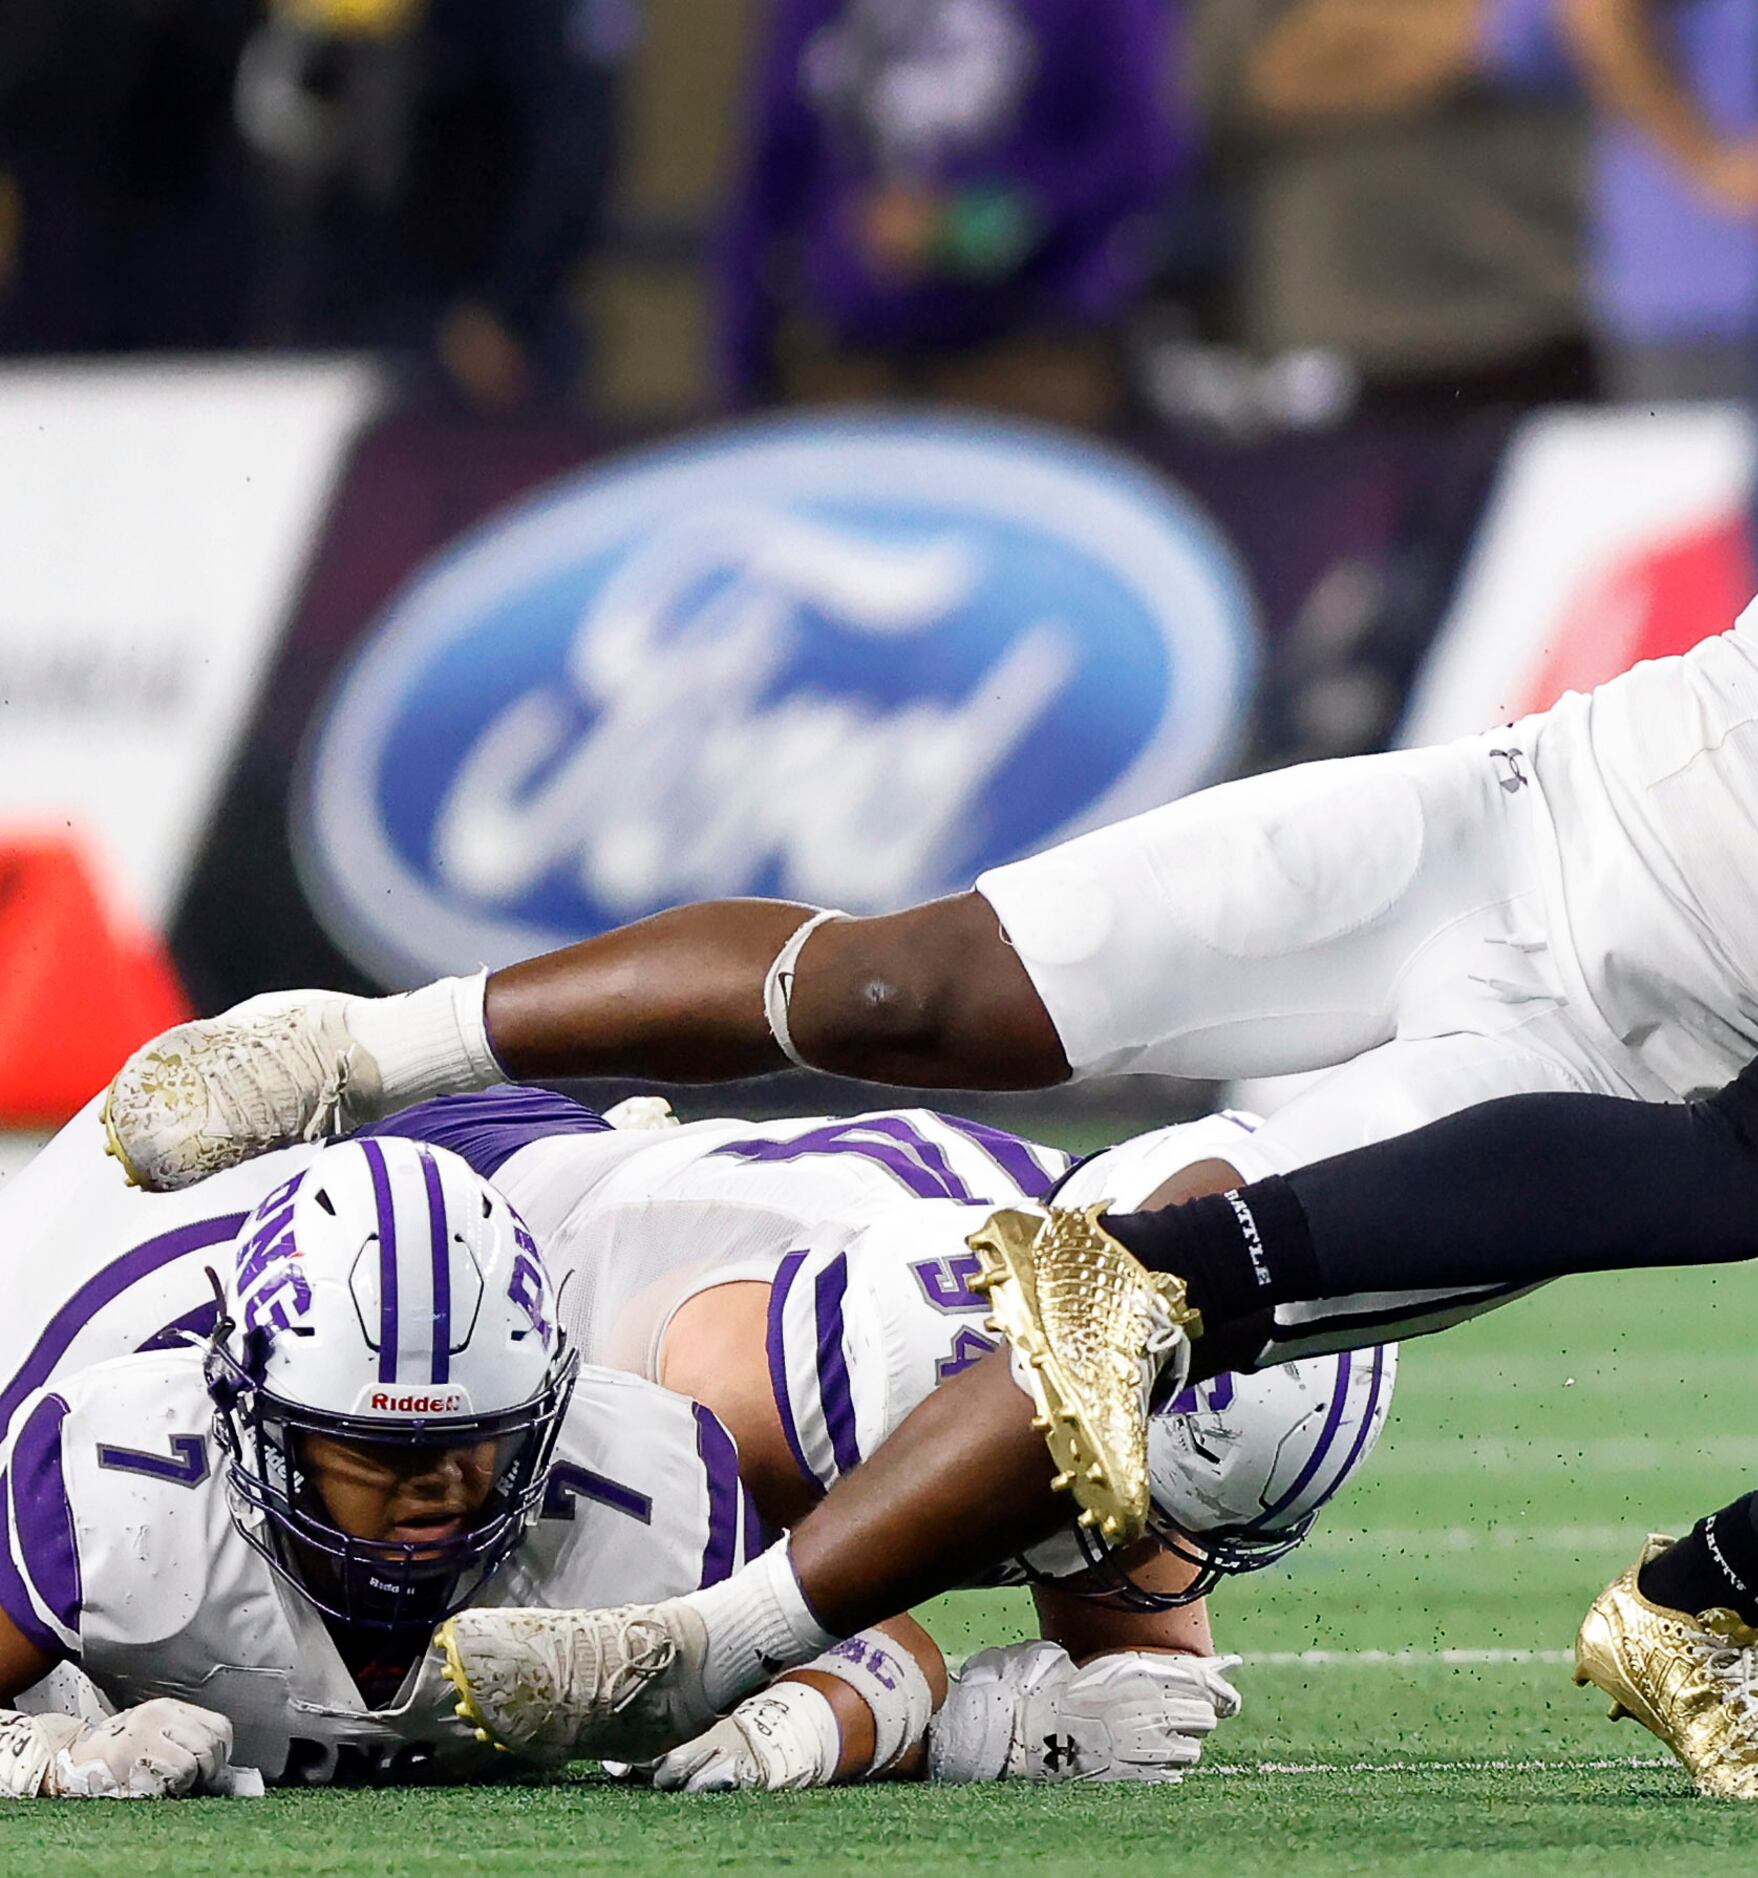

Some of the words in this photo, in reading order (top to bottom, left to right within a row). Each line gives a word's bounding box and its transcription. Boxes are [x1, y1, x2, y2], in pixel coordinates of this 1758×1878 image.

[432, 505, 1082, 905] Ford
[1223, 1188, 1273, 1286] BATTLE
[96, 1432, 212, 1490] 7
[539, 1458, 652, 1527] 7
[368, 1575, 416, 1597] Riddll
